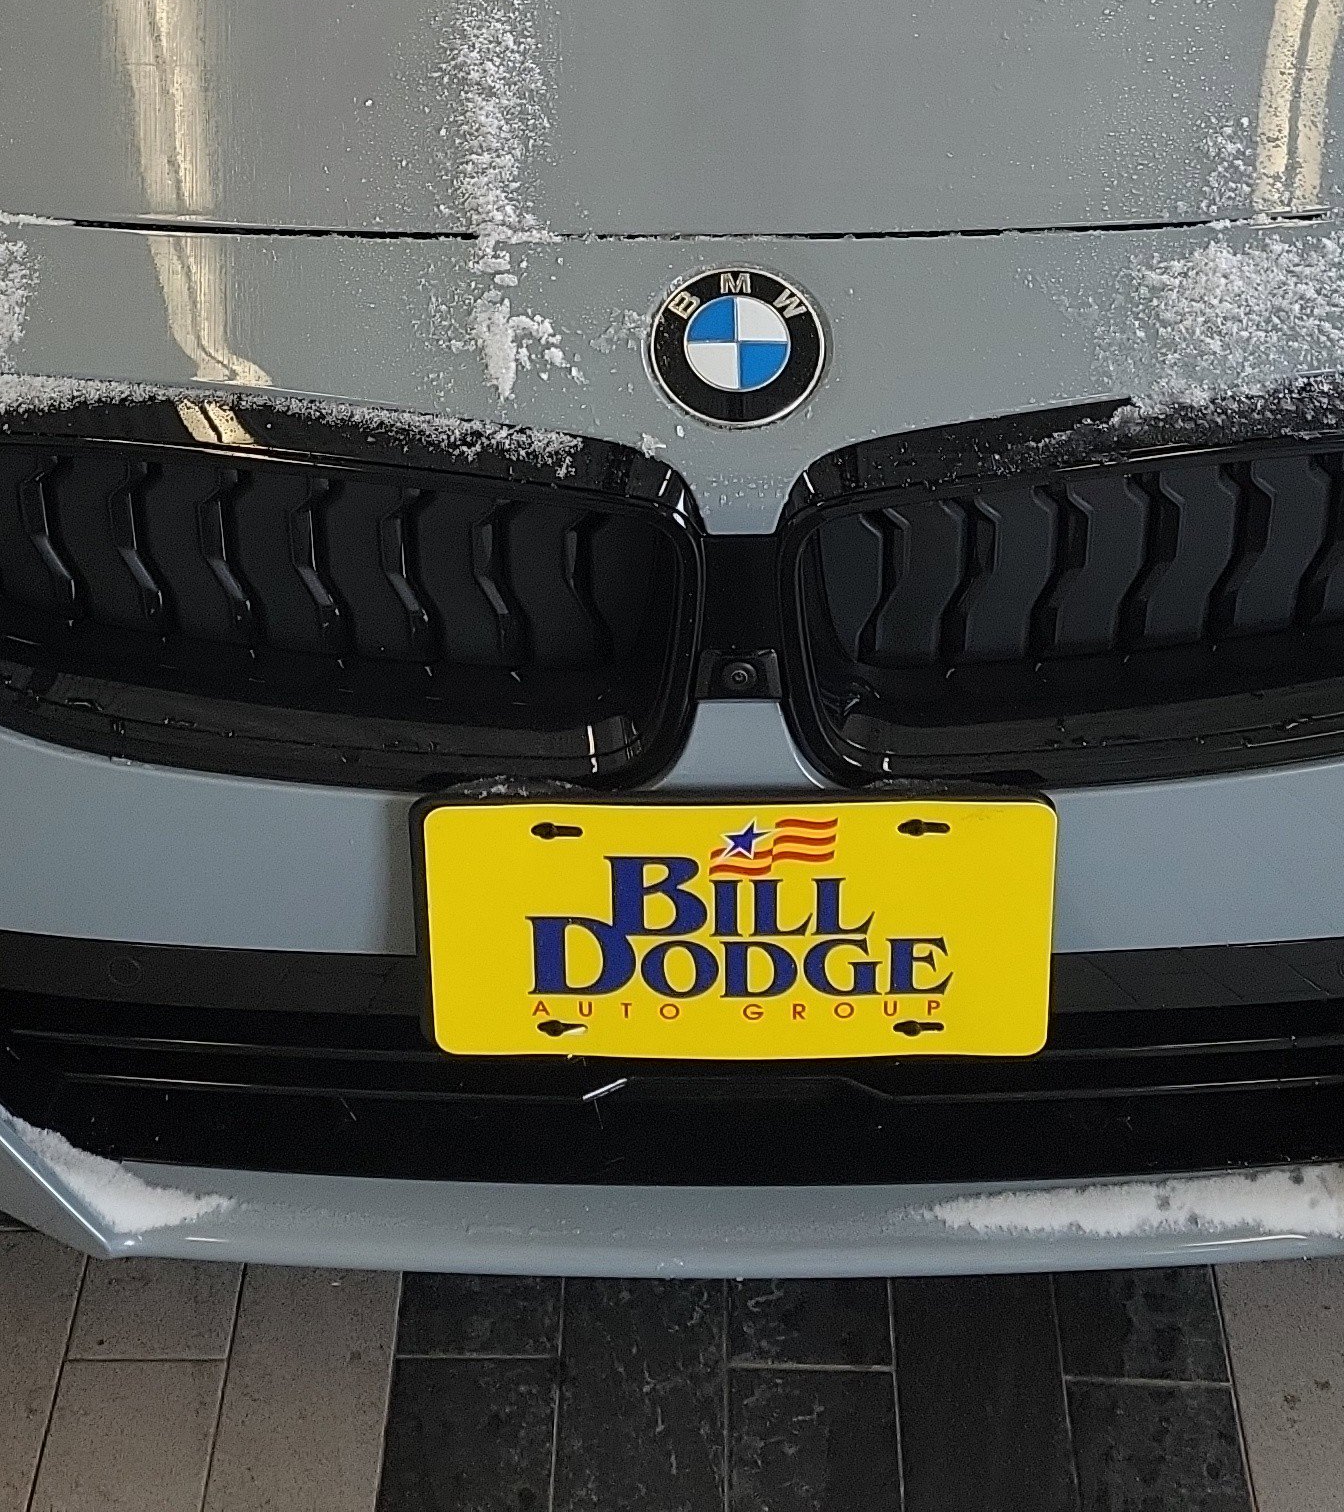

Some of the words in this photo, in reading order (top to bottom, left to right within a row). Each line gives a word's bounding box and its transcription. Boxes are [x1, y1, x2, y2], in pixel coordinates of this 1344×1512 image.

[667, 272, 808, 320] BMW
[603, 855, 875, 937] BILL
[524, 915, 954, 999] DODGE
[532, 1000, 681, 1020] AUTO
[742, 1000, 941, 1020] GROUP
